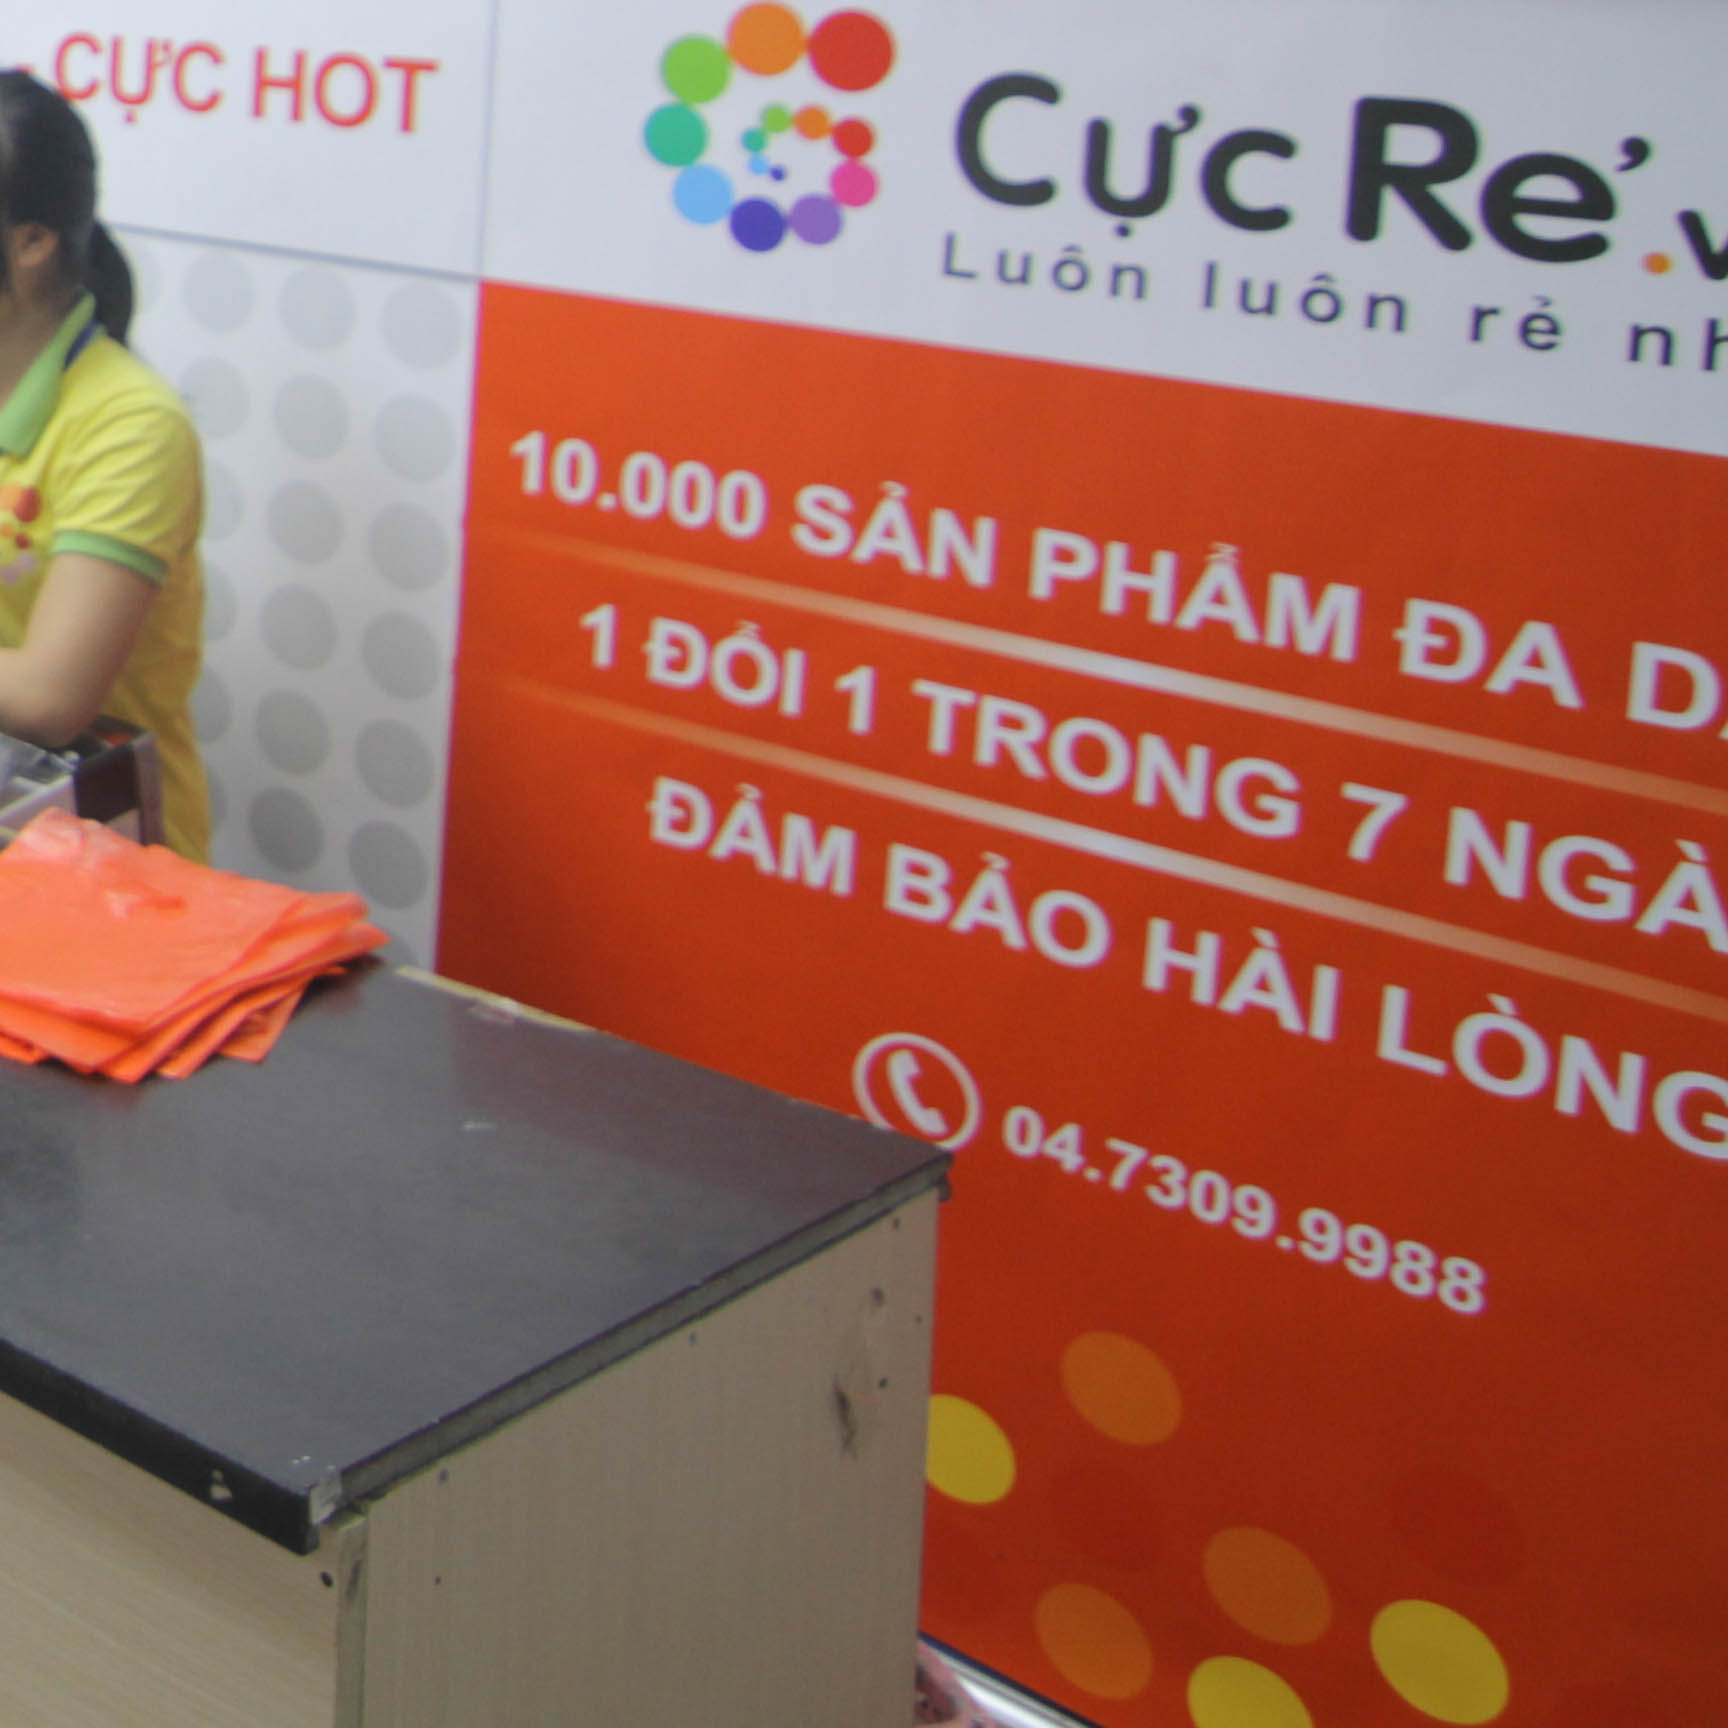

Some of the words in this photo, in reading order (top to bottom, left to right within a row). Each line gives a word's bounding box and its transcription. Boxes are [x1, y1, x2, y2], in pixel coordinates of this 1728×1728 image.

[53, 30, 224, 124] CỰC
[251, 46, 439, 134] HOT
[942, 233, 1149, 302] Luôn
[1200, 260, 1410, 334] luôn
[1469, 295, 1563, 353] rẻ
[508, 429, 766, 540] 10.000
[791, 479, 999, 590] SẢN
[1028, 525, 1361, 666] PHẨM
[1393, 596, 1584, 711] ĐA
[1626, 639, 1728, 740] D
[578, 603, 618, 670] 1
[644, 617, 806, 719] ĐỔI
[831, 664, 879, 736] 1
[911, 674, 1304, 842] TRONG
[1338, 779, 1407, 865] 7
[646, 774, 858, 897] ĐẢM
[882, 850, 1111, 972] BẢO
[1142, 916, 1338, 1043] HÀI
[1375, 981, 1728, 1165] LÒNG
[1000, 1104, 1489, 1315] 04.7309.9988
